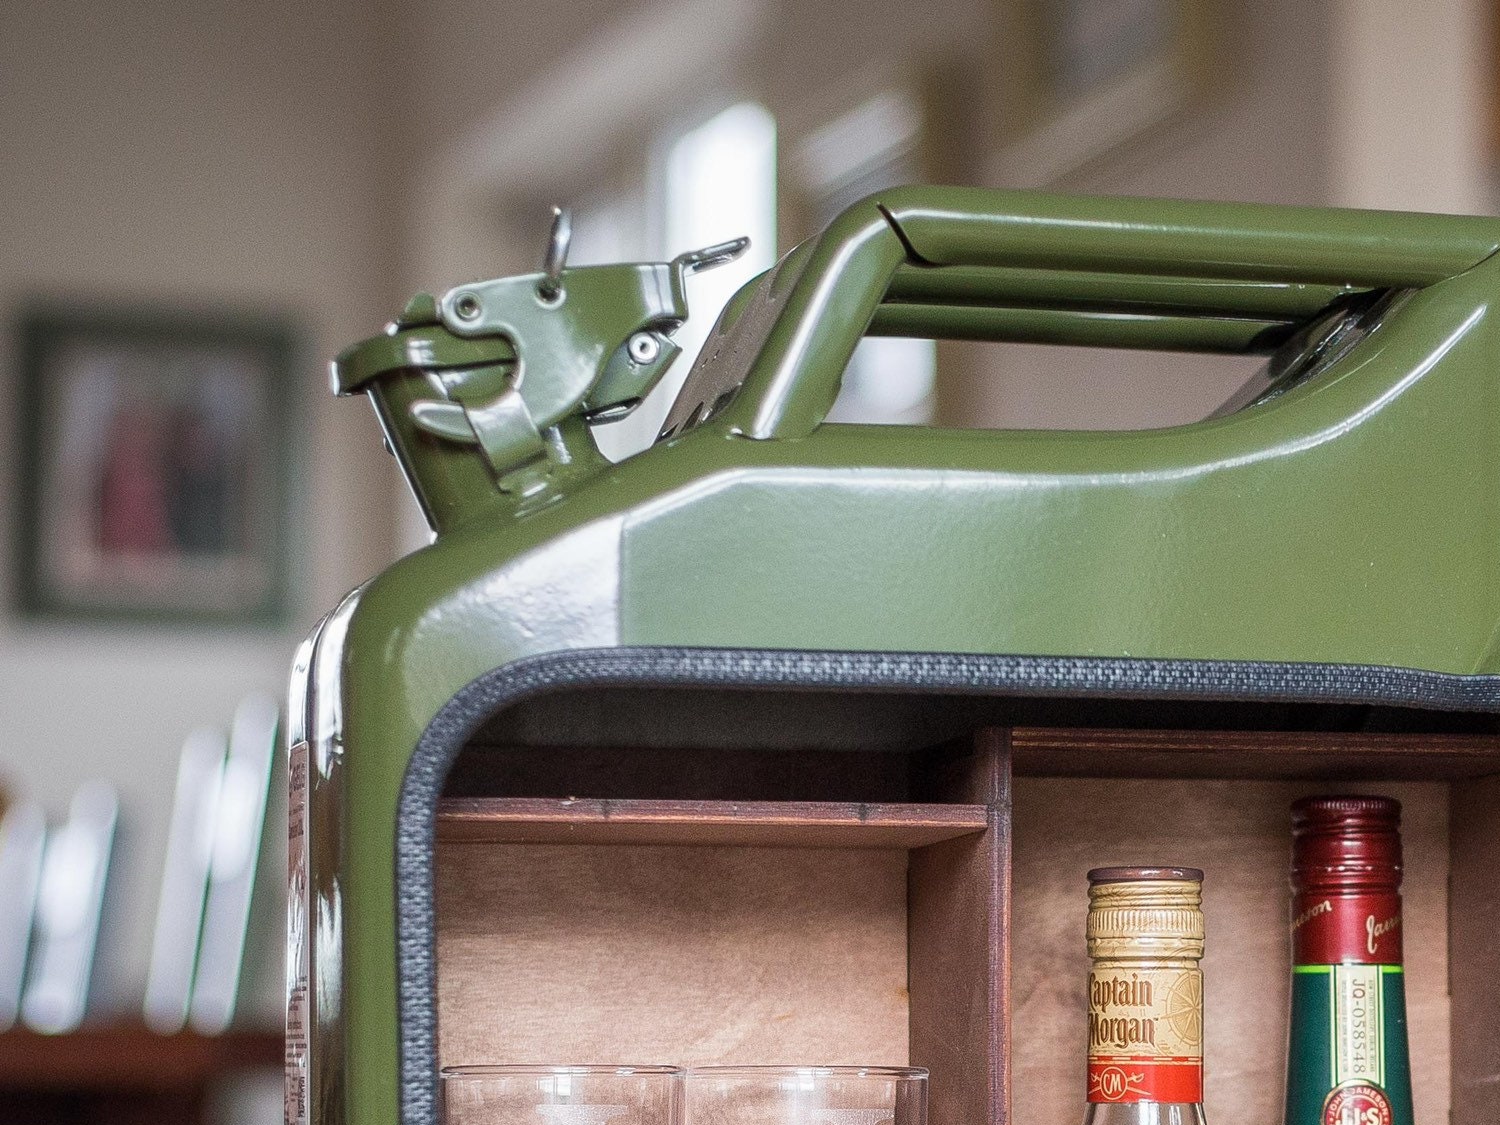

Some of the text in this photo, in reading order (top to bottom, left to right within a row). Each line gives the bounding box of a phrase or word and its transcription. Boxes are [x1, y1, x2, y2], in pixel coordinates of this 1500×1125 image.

[1089, 972, 1153, 1013] Captain
[1088, 1013, 1156, 1048] Morgan
[1102, 1072, 1122, 1095] CM
[1351, 1086, 1388, 1116] JAMESON
